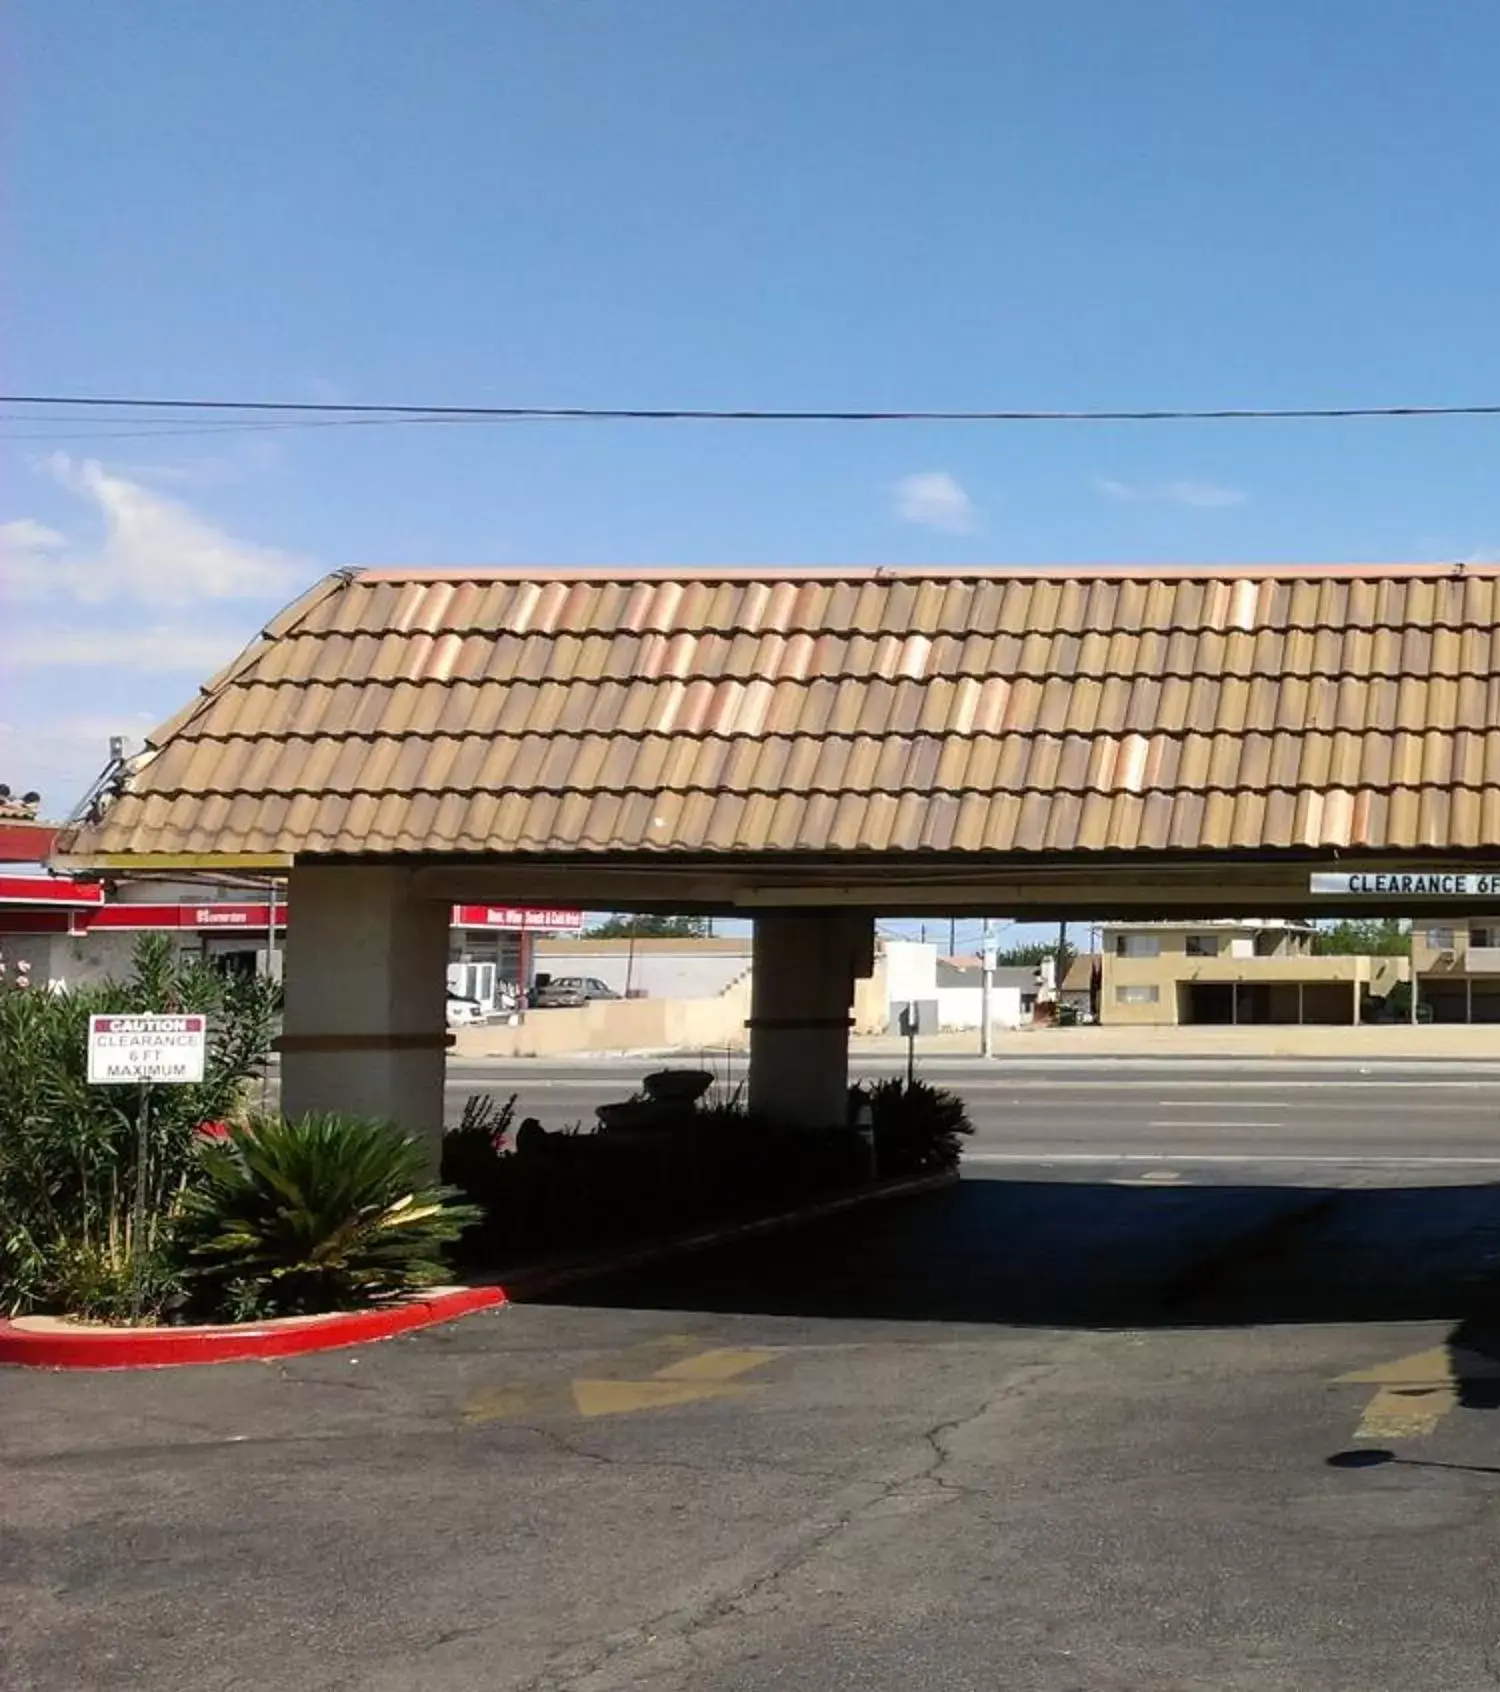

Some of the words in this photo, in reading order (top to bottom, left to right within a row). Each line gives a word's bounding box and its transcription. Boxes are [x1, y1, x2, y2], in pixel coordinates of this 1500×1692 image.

[1349, 875, 1466, 894] CLEARANCE
[109, 1018, 185, 1033] CAUTION
[97, 1035, 198, 1048] CLEARANCE
[129, 1049, 138, 1062] 6
[143, 1049, 161, 1062] FT
[107, 1064, 186, 1077] MAXIMUM
